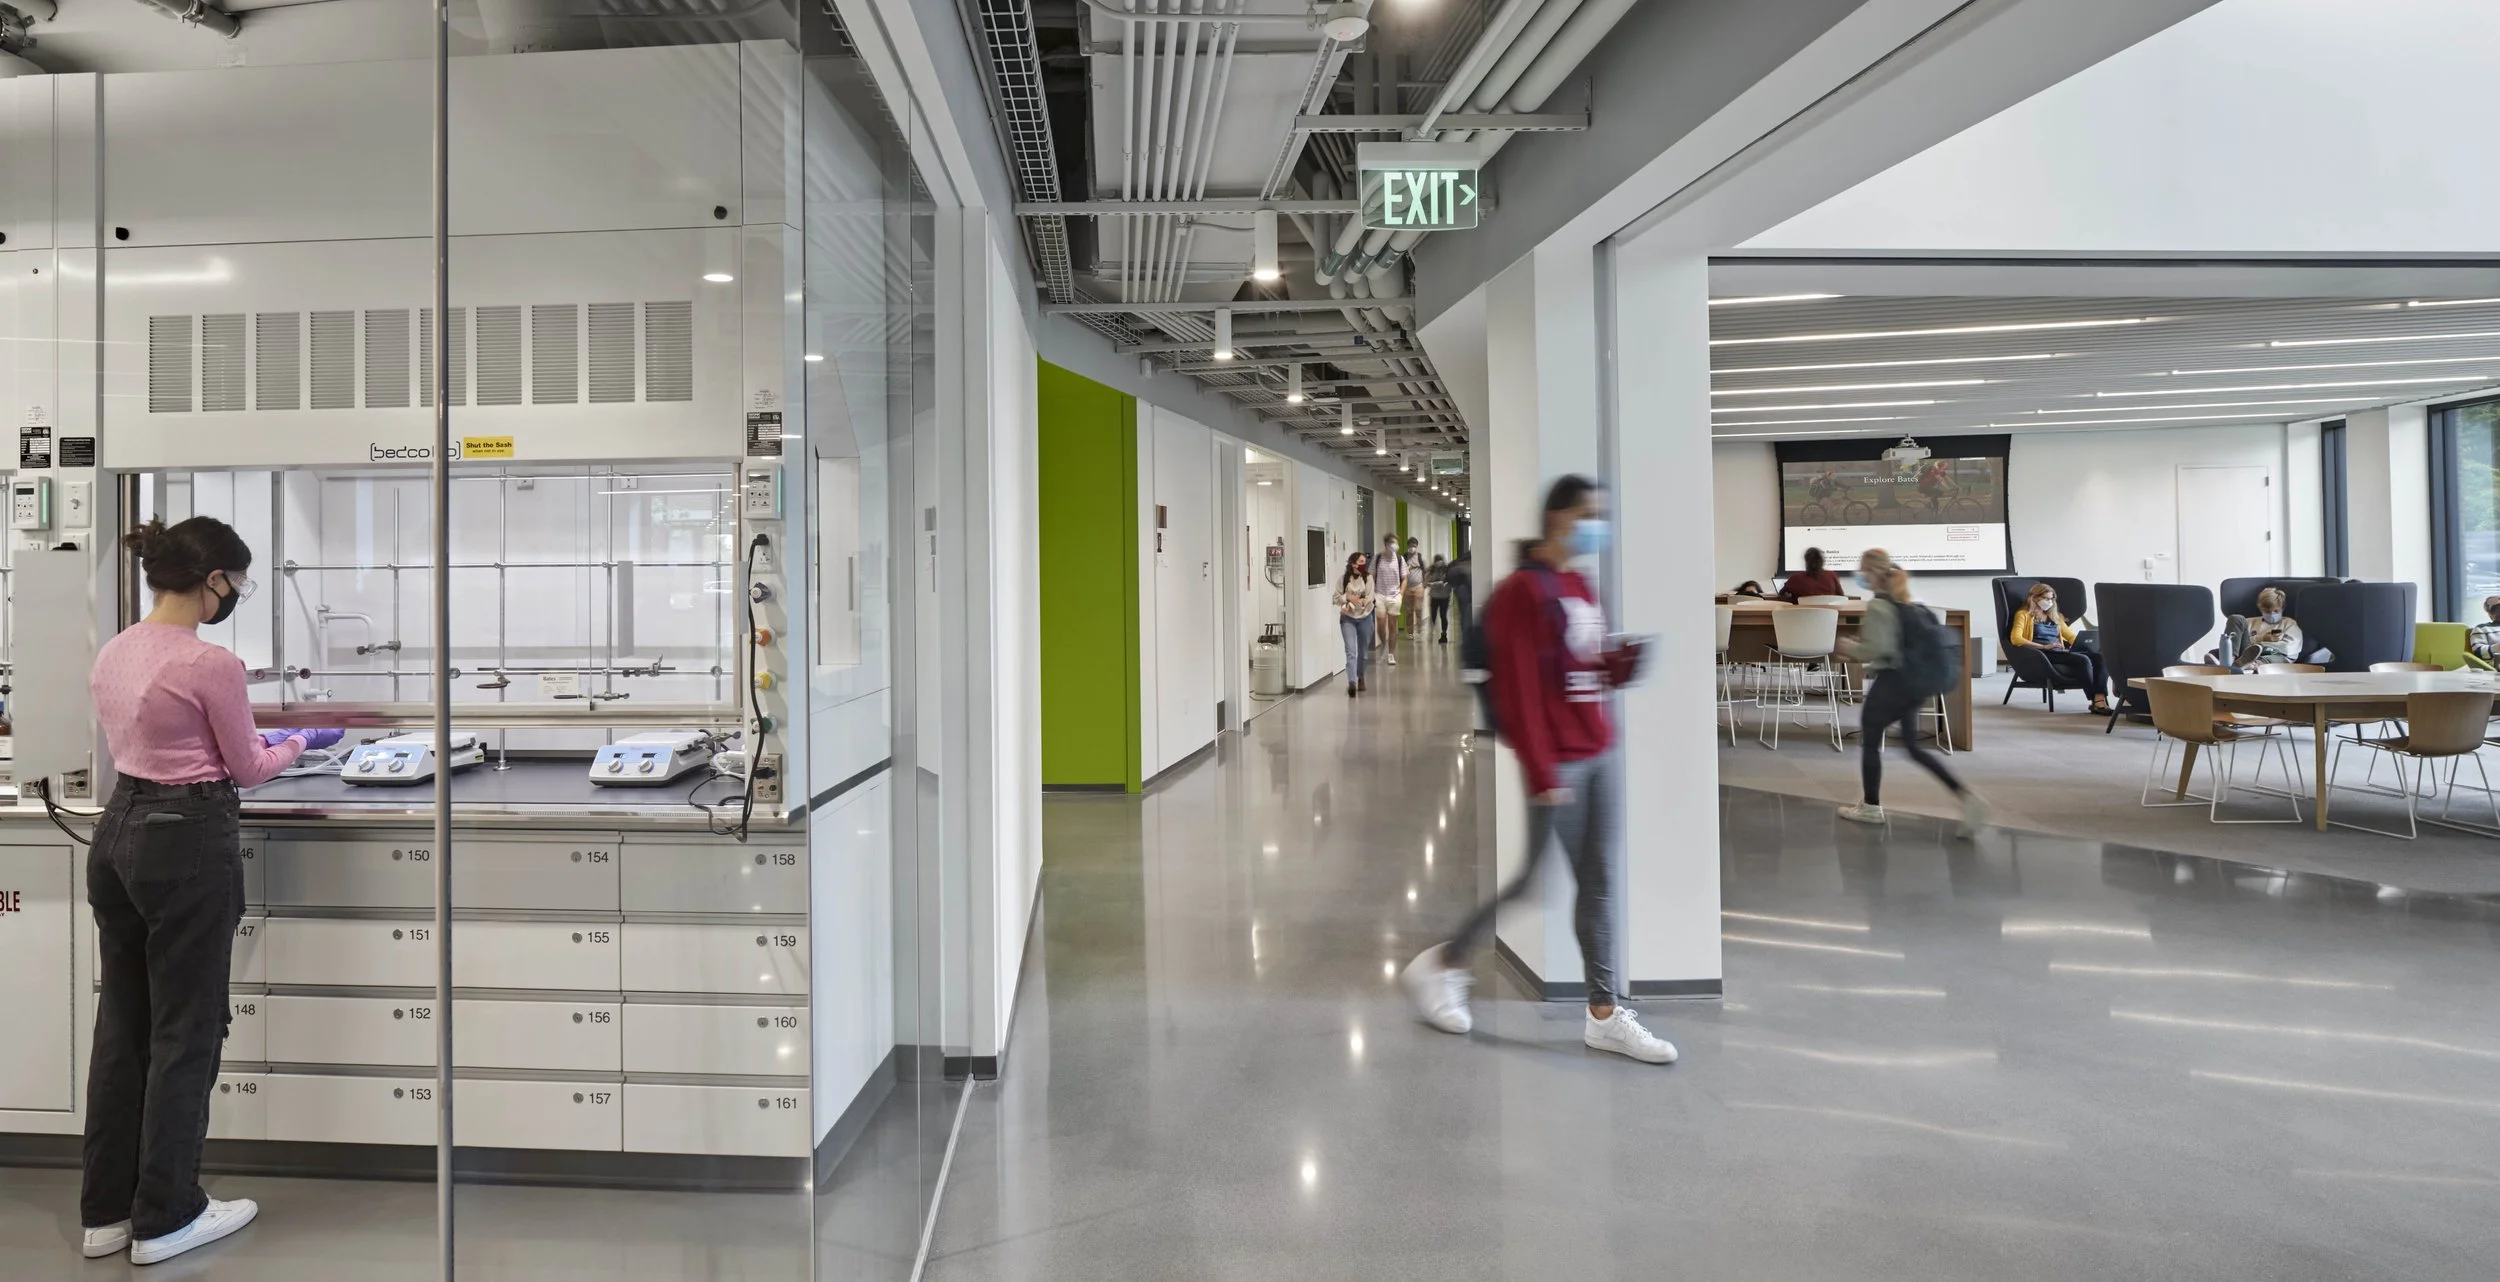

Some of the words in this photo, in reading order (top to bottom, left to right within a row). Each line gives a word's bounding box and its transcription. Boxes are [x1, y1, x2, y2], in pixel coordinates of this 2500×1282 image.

[1383, 172, 1459, 225] EXIT
[1863, 476, 1895, 485] Explore
[1897, 475, 1919, 483] Bates
[240, 847, 254, 859] 46
[407, 849, 430, 862] 150
[587, 851, 609, 863] 154
[772, 853, 796, 866] 158
[235, 925, 255, 937] 147
[409, 929, 430, 941] 151
[587, 931, 610, 944] 155
[773, 934, 797, 948] 159
[234, 1003, 256, 1016] 148
[408, 1007, 431, 1020] 152
[588, 1011, 611, 1024] 156
[774, 1015, 798, 1029] 160
[235, 1082, 257, 1095] 149
[409, 1088, 432, 1101] 153
[589, 1092, 612, 1105] 157
[776, 1097, 798, 1110] 161
